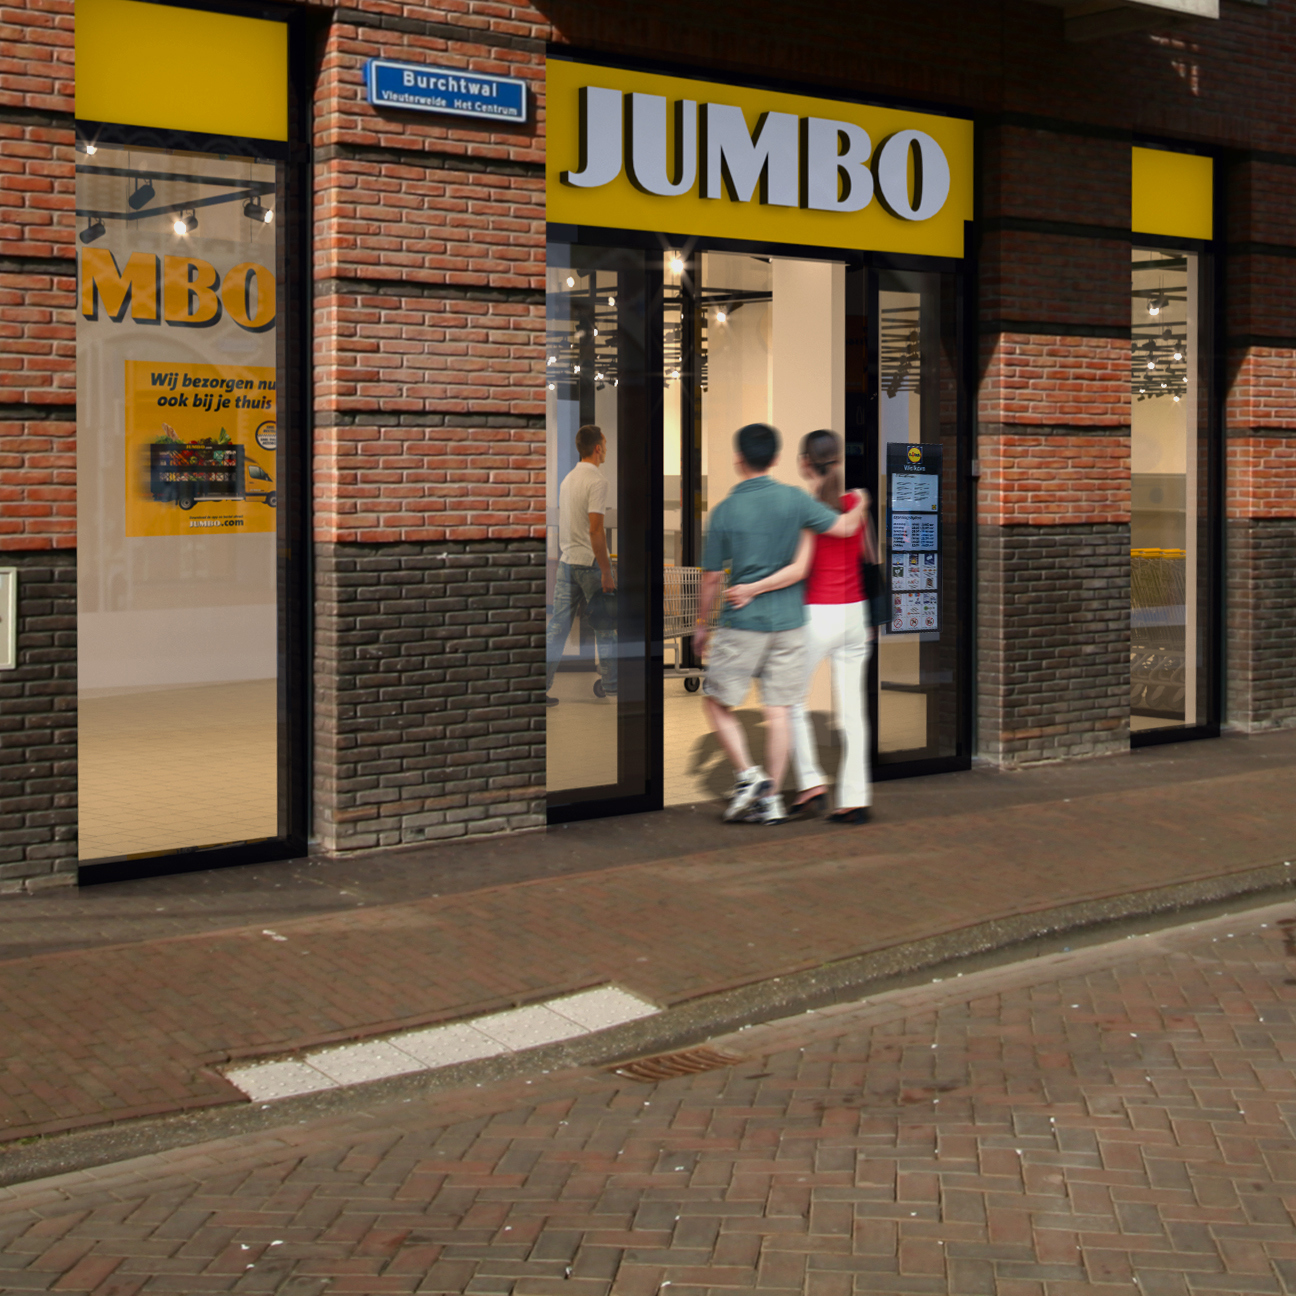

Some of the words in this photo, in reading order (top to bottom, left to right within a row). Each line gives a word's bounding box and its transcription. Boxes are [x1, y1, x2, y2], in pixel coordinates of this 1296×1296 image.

[403, 71, 497, 97] Burchtwal
[382, 90, 447, 107] Vleuterweide
[454, 99, 473, 110] Het
[475, 101, 518, 116] Centrum
[560, 86, 950, 221] JUMBO
[82, 247, 276, 333] MBO
[151, 373, 179, 391] Wij
[182, 373, 254, 393] bezorgen
[258, 380, 276, 391] nu
[157, 393, 189, 407] ook
[192, 393, 213, 412] bij
[214, 394, 231, 412] je
[235, 395, 272, 410] thuis
